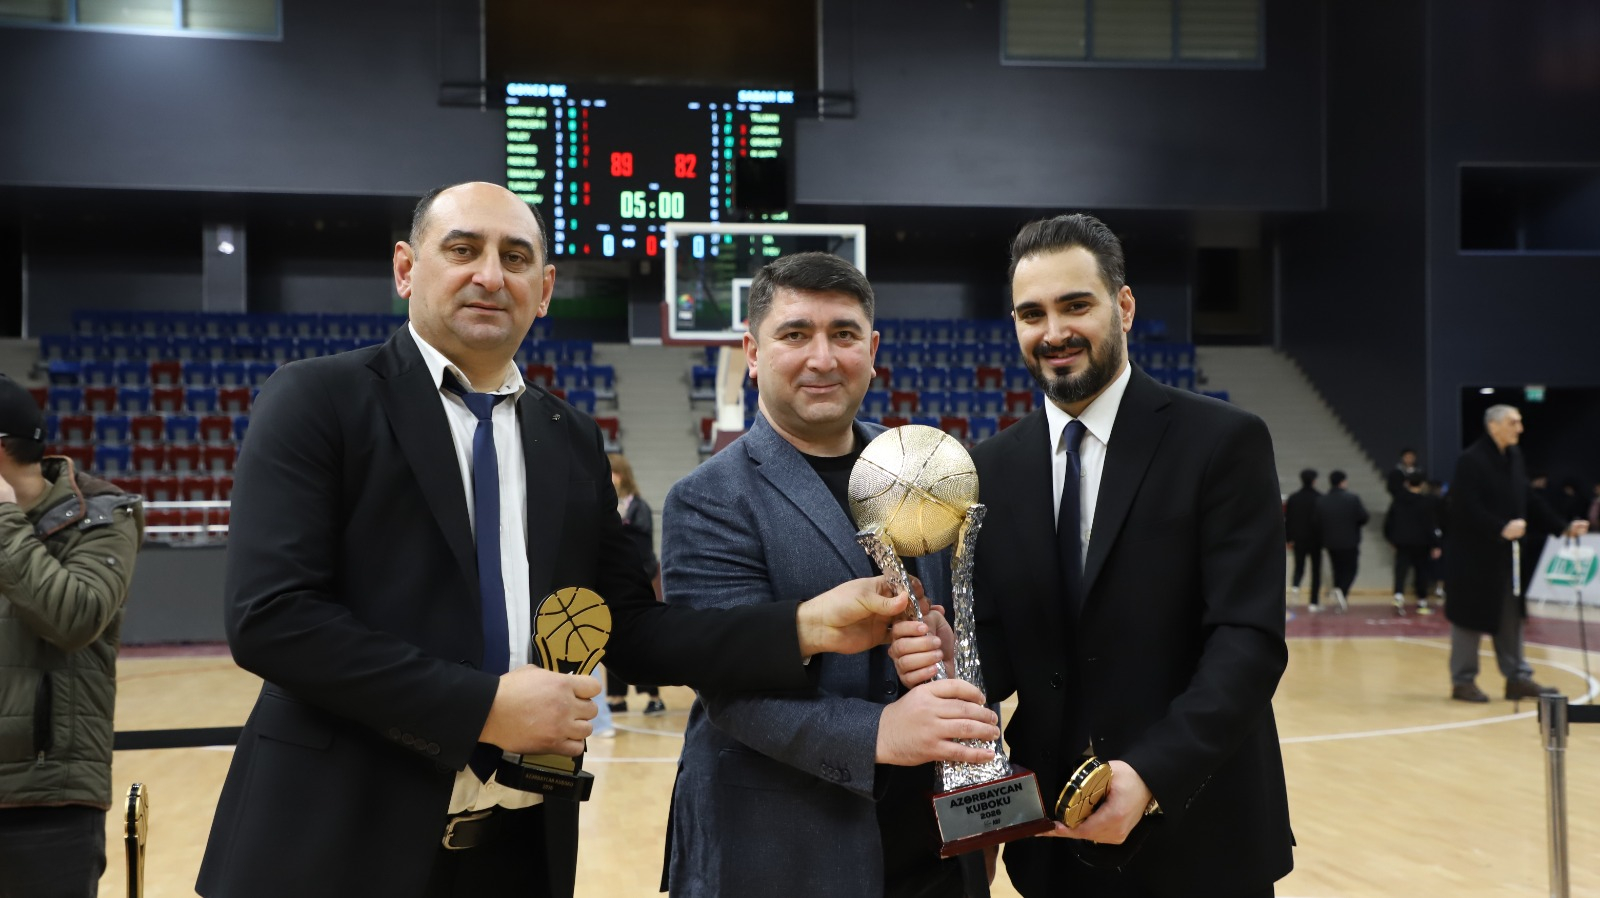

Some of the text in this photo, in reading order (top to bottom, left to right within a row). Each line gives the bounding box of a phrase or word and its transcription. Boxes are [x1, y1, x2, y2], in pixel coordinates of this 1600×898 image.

[610, 152, 633, 177] 89
[674, 153, 697, 178] 82
[620, 190, 684, 219] 05:00
[603, 234, 615, 257] 0
[646, 235, 657, 256] 0
[692, 235, 705, 258] 0
[950, 783, 1023, 808] AZƏRBAYCAN
[966, 796, 1011, 815] KUBOKU
[980, 809, 1002, 820] 2026
